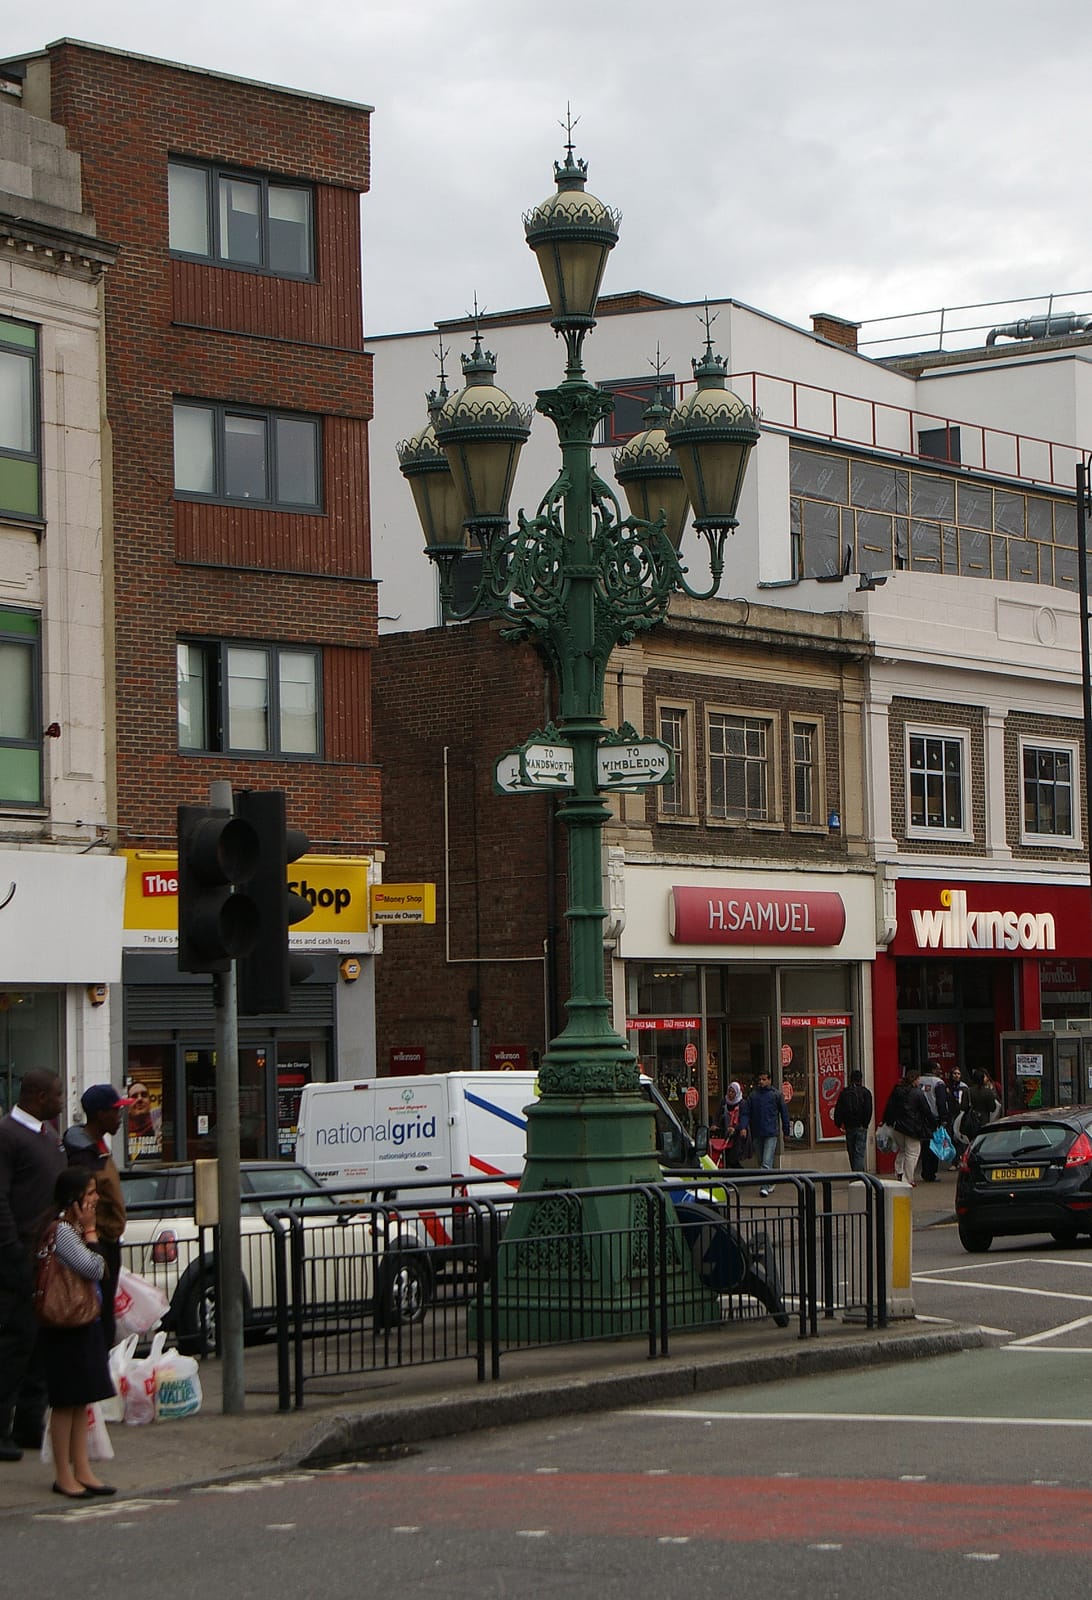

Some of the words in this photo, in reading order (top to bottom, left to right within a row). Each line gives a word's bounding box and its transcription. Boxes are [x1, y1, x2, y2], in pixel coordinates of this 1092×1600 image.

[544, 749, 553, 758] TO
[626, 748, 639, 757] TO
[602, 757, 665, 770] WIMBLEDON
[145, 874, 178, 893] The
[384, 895, 405, 904] Money
[406, 895, 423, 903] Shop
[402, 912, 422, 920] Change
[708, 900, 815, 932] H.SAMUEL
[911, 889, 1056, 950] wilkinson
[144, 935, 156, 943] The
[304, 937, 316, 945] and
[318, 937, 332, 945] cash
[333, 937, 351, 945] loans
[494, 1051, 520, 1061] wilkinson
[819, 1047, 842, 1058] HALF
[819, 1056, 843, 1066] PRICE
[820, 1063, 844, 1074] SALE
[316, 1114, 436, 1146] nationalgrid
[379, 1150, 432, 1161] nationalgrid.com
[1019, 1168, 1036, 1177] TUA
